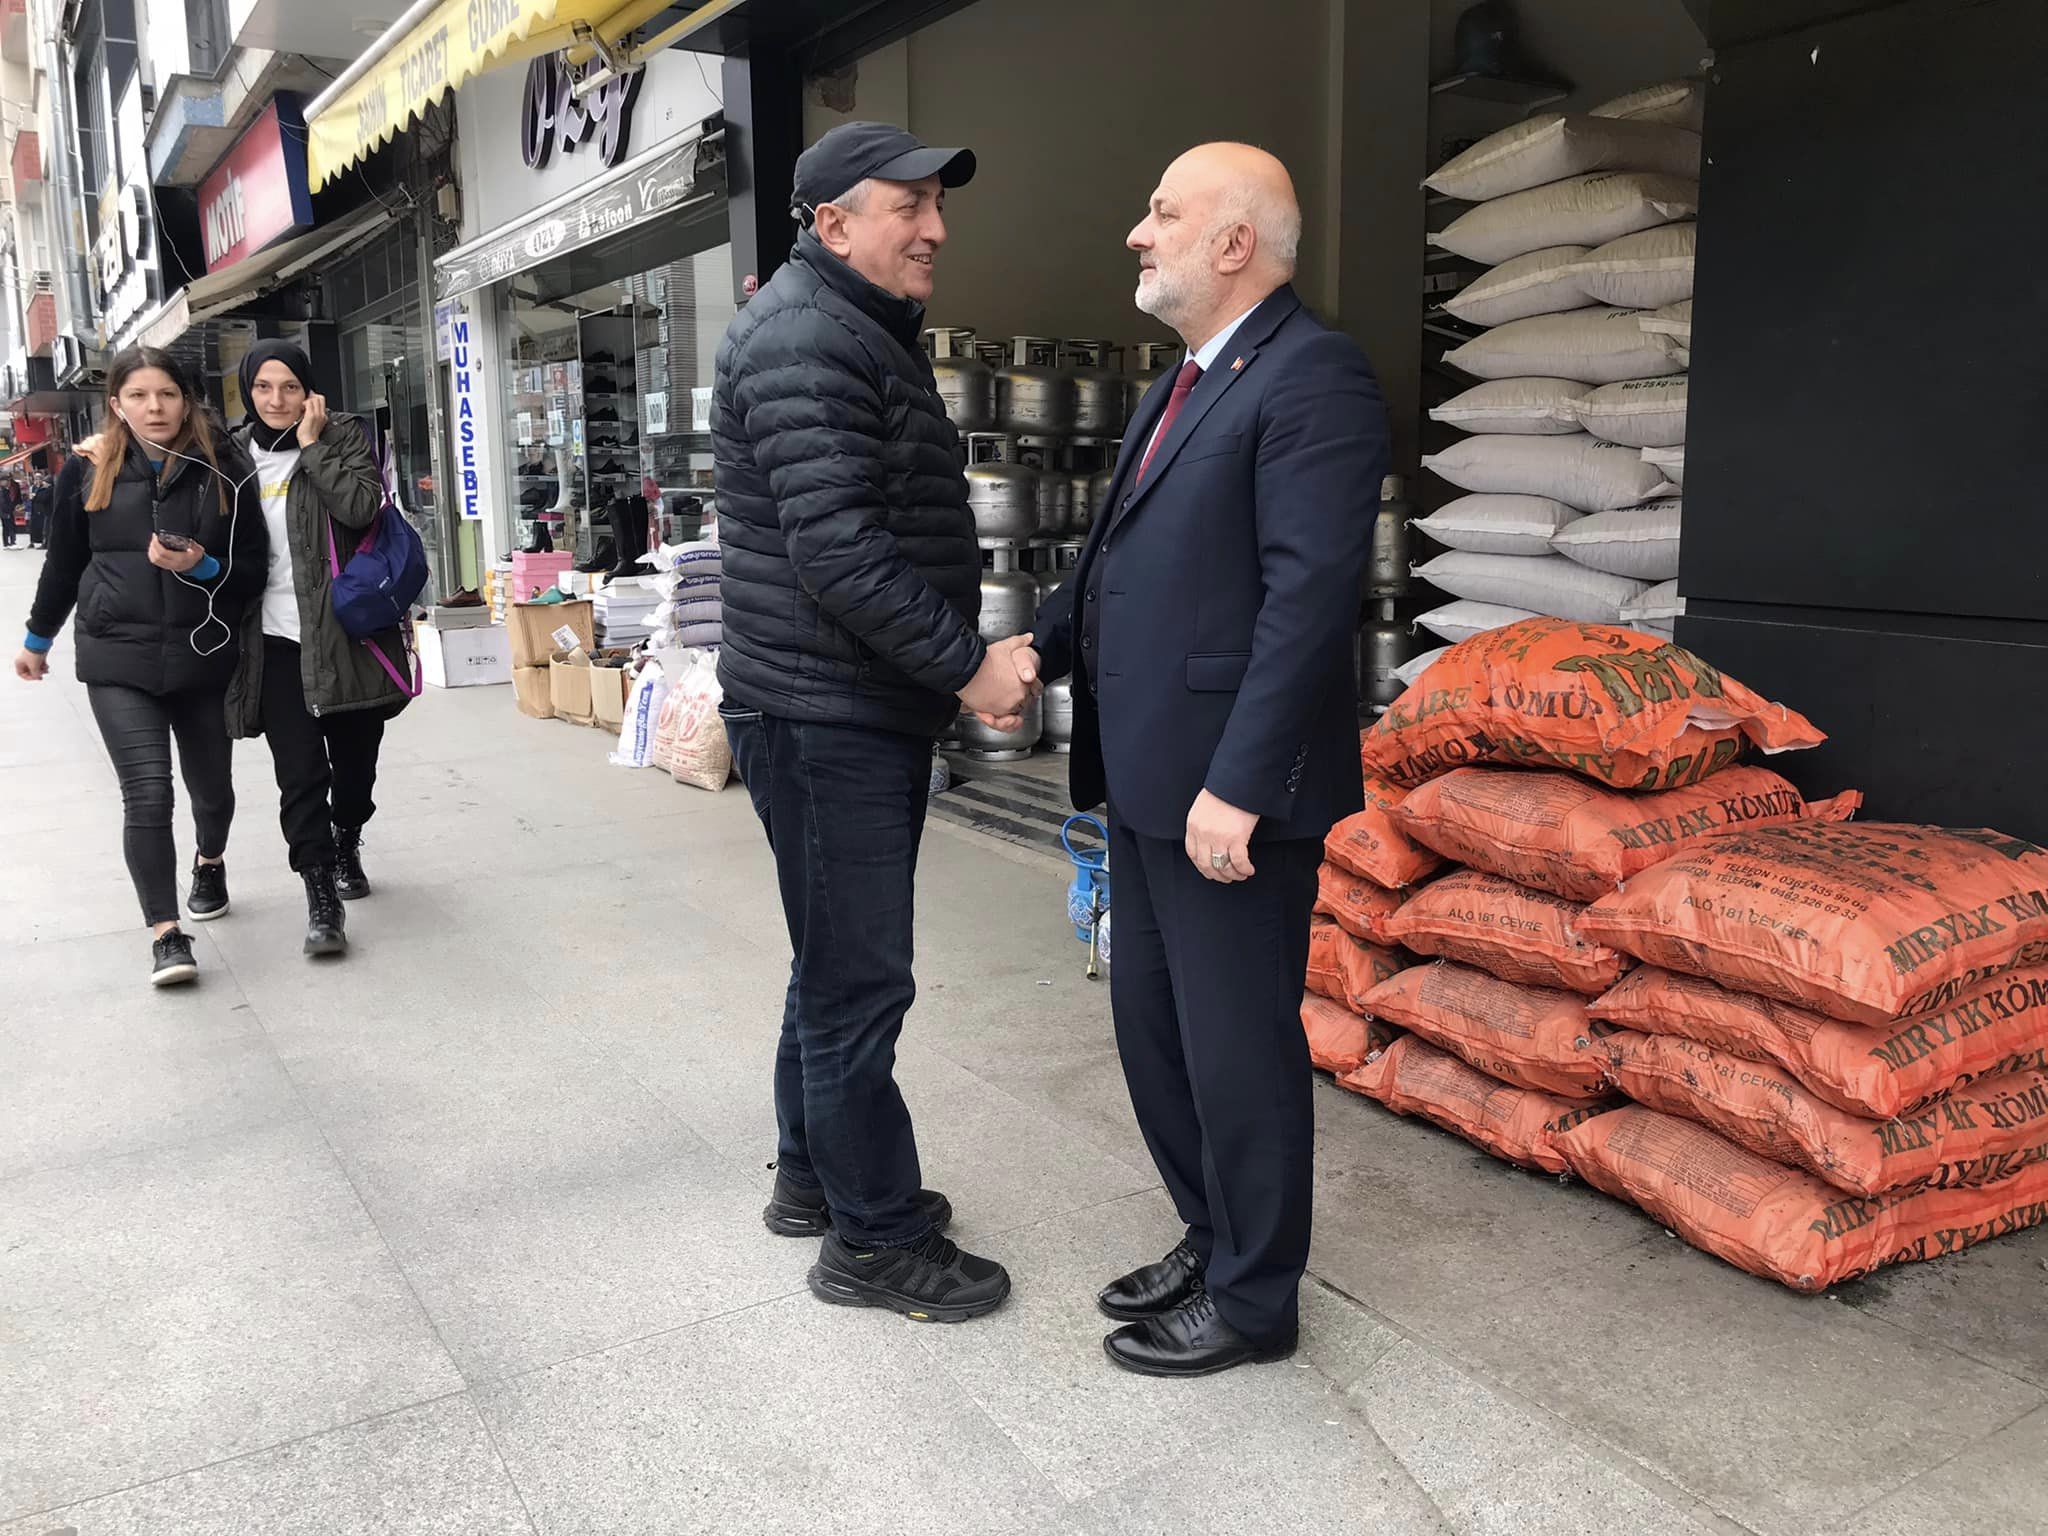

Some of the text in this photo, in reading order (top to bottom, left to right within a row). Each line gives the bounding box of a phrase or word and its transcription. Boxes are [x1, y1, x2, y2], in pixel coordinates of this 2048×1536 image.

[452, 321, 479, 516] MUHASEBE
[1723, 862, 1771, 879] TELEFON
[1810, 883, 1832, 897] 435
[1833, 892, 1850, 904] 99
[1478, 910, 1495, 923] 181
[1682, 894, 1713, 913] ALO
[1719, 906, 1743, 923] 181
[1800, 895, 1823, 909] 326
[1824, 902, 1840, 915] 62
[1840, 908, 1858, 921] 33
